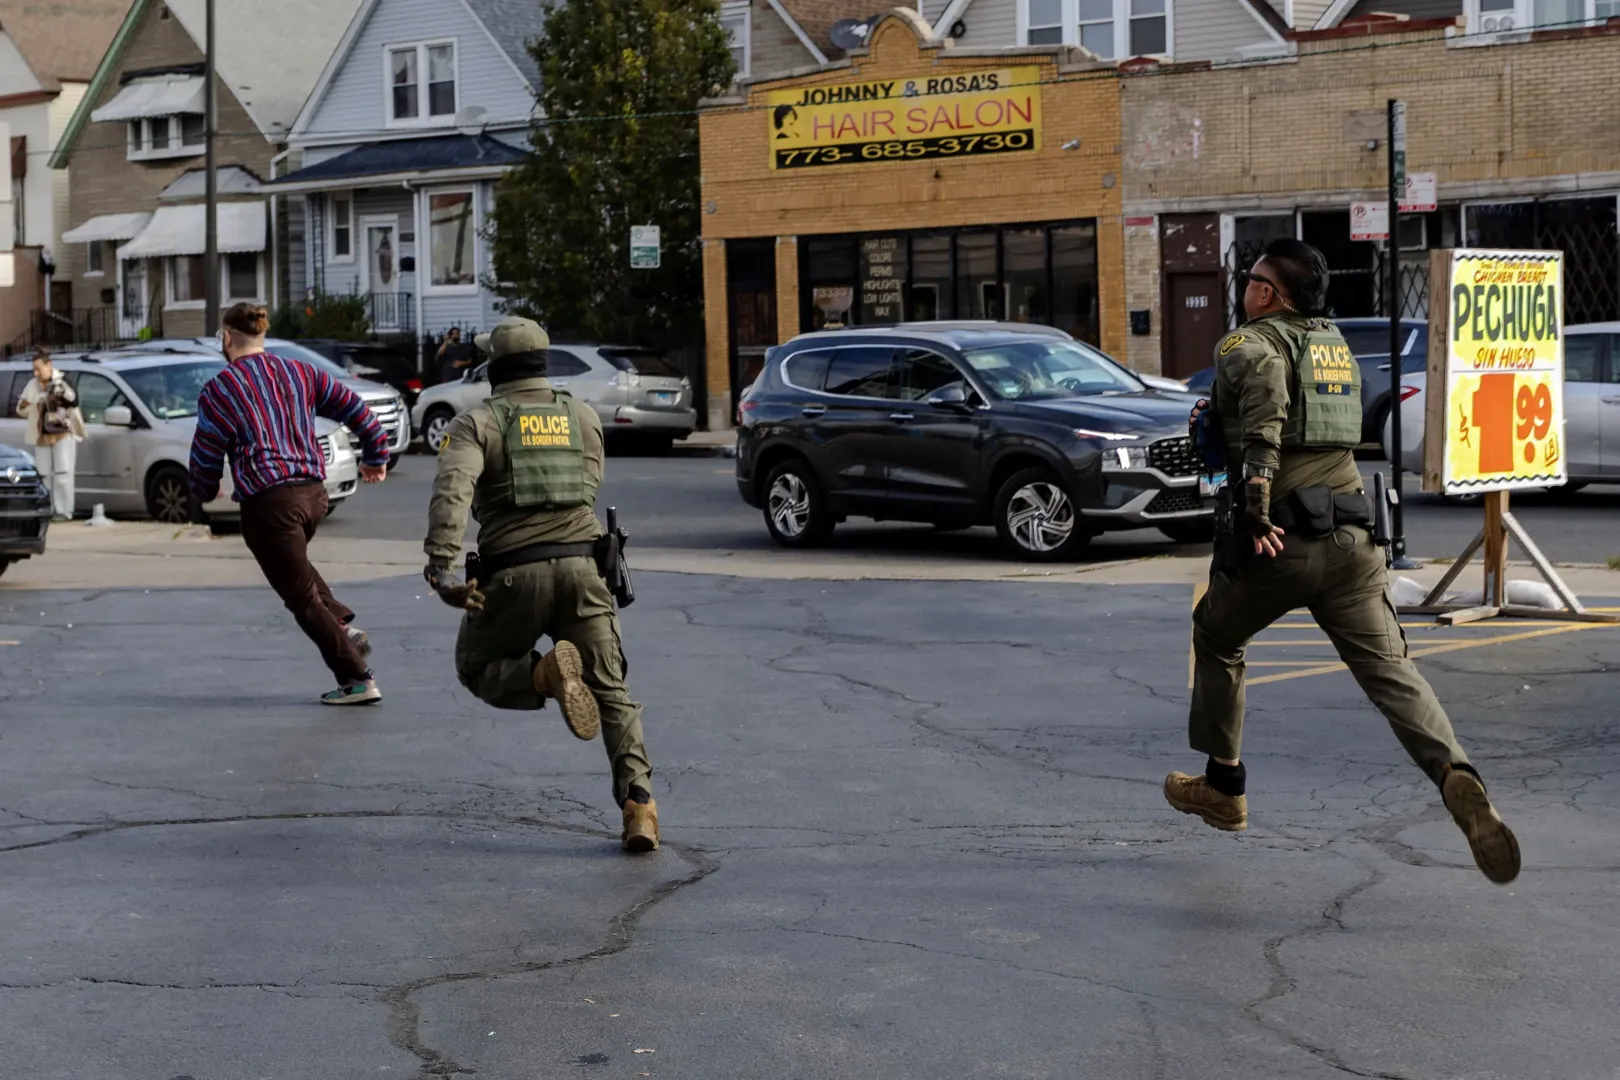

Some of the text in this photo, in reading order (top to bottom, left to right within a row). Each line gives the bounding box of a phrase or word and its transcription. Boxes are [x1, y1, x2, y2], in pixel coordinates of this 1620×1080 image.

[798, 73, 999, 106] JOHNNY & ROSA'S
[812, 97, 1032, 141] HAIR SALON
[1453, 283, 1558, 342] PECHUGA
[1310, 344, 1352, 368] POLICE
[1473, 346, 1536, 369] SIN HUESO
[520, 415, 570, 435] POLICE
